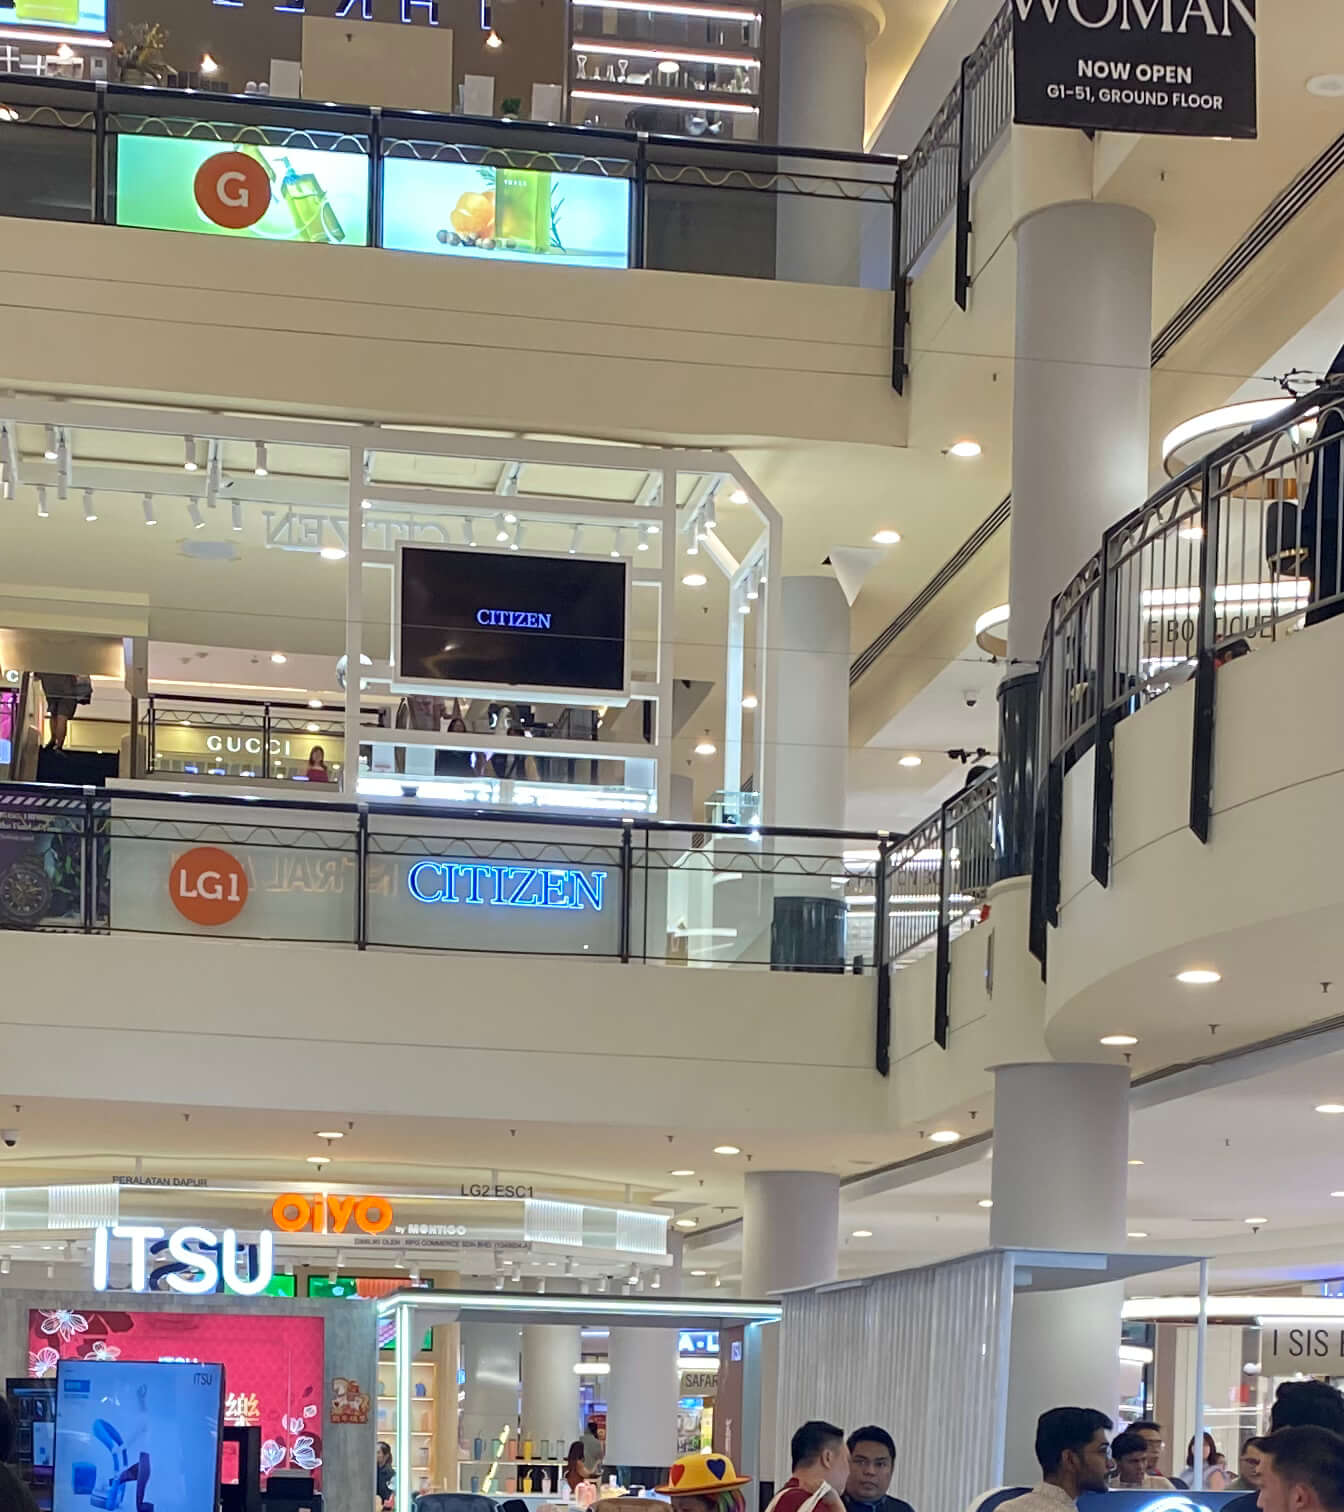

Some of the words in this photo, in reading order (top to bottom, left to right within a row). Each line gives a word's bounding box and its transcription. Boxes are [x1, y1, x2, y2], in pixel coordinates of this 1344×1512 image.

[1078, 59, 1131, 80] NOW
[1135, 64, 1193, 84] OPEN
[1099, 89, 1169, 106] GROUND
[1172, 93, 1223, 110] FLOOR
[216, 172, 249, 207] G
[476, 609, 552, 629] CITIZEN
[207, 736, 291, 756] GUCCI
[179, 869, 241, 902] LG1
[407, 861, 608, 911] CITIZEN
[112, 1176, 170, 1187] PERALATAN
[173, 1178, 208, 1188] DAPUR
[461, 1184, 490, 1197] LG2
[495, 1185, 534, 1198] ESC1
[408, 1223, 467, 1235] MONTIGO
[93, 1226, 273, 1295] ITSU
[1289, 1329, 1329, 1357] SIS
[193, 1373, 213, 1386] ITSU
